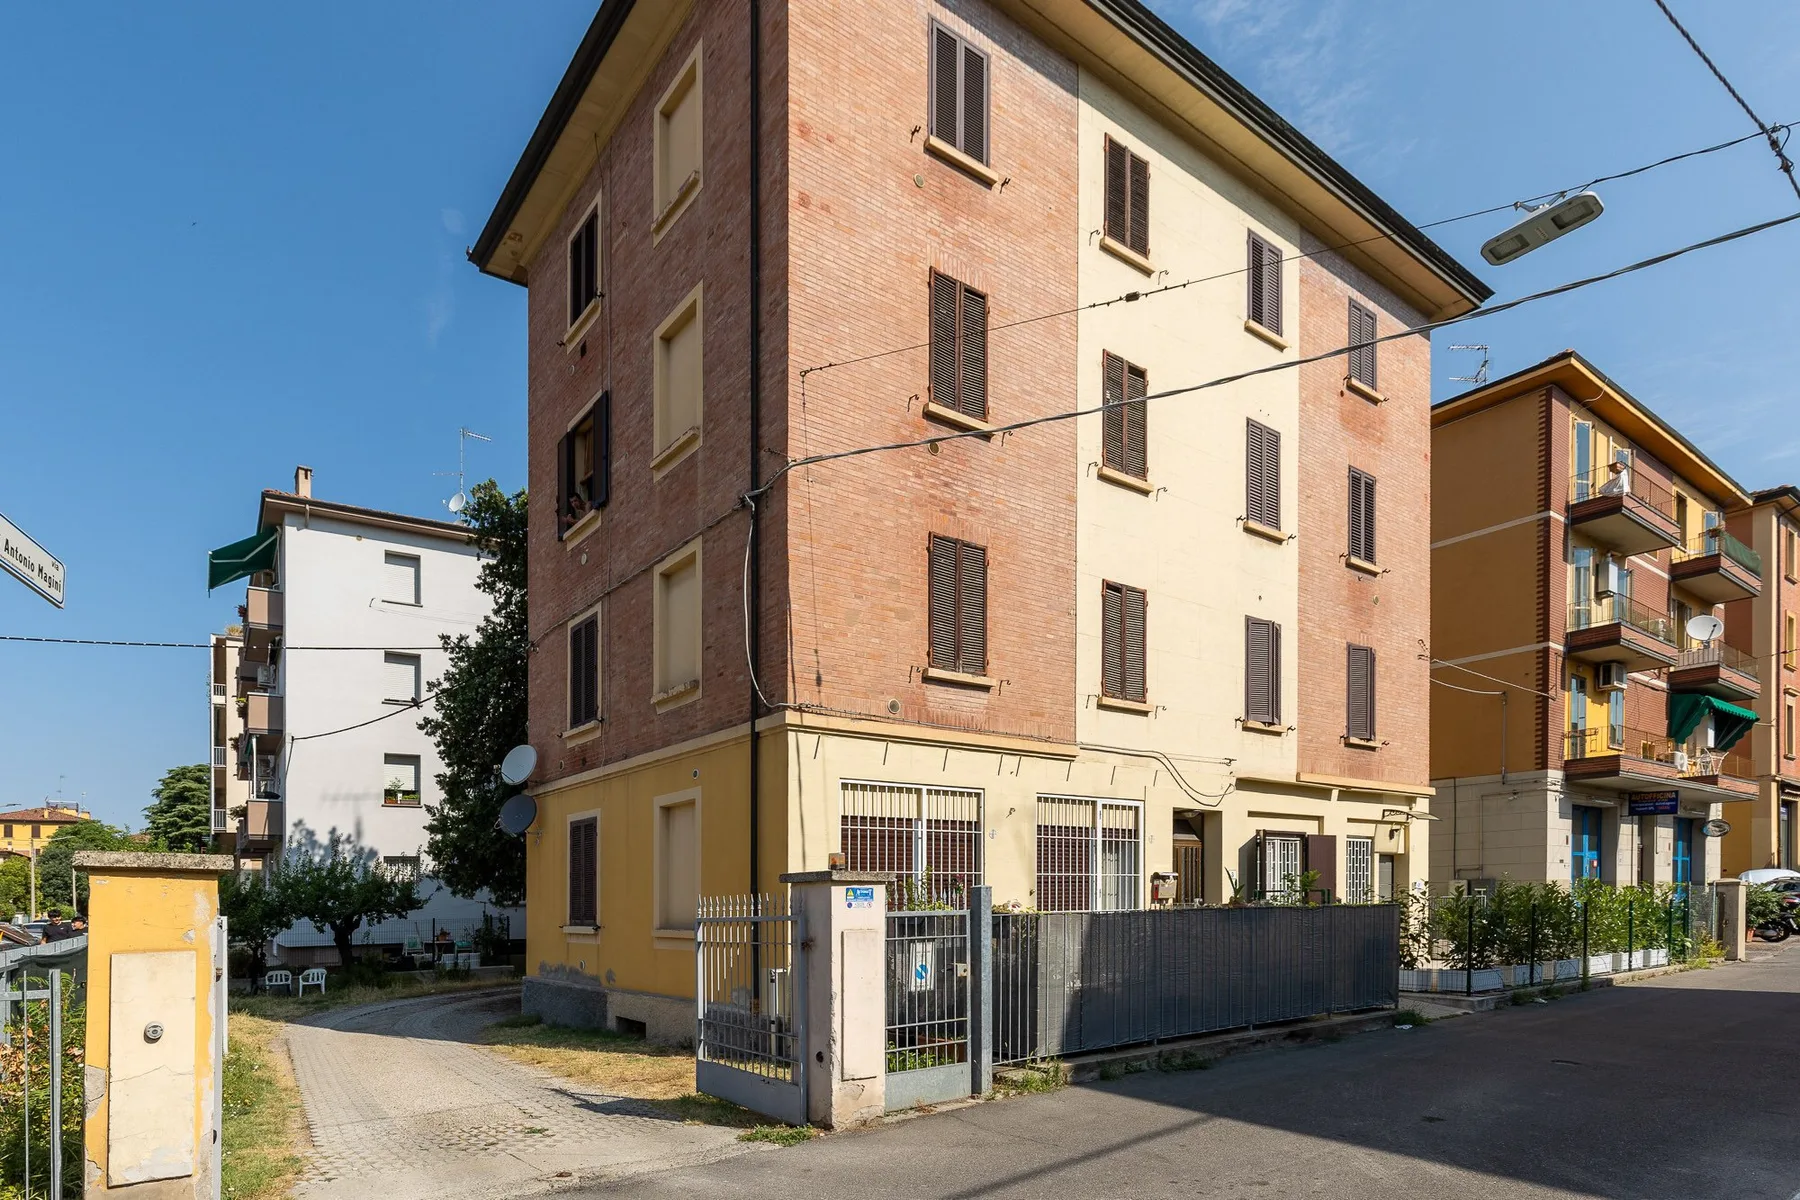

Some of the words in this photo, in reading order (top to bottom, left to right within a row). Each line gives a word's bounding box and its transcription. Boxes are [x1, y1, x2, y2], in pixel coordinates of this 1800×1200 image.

[4, 538, 35, 572] Antonio
[37, 563, 61, 593] Magini
[1631, 792, 1676, 800] AUTOFFICINA
